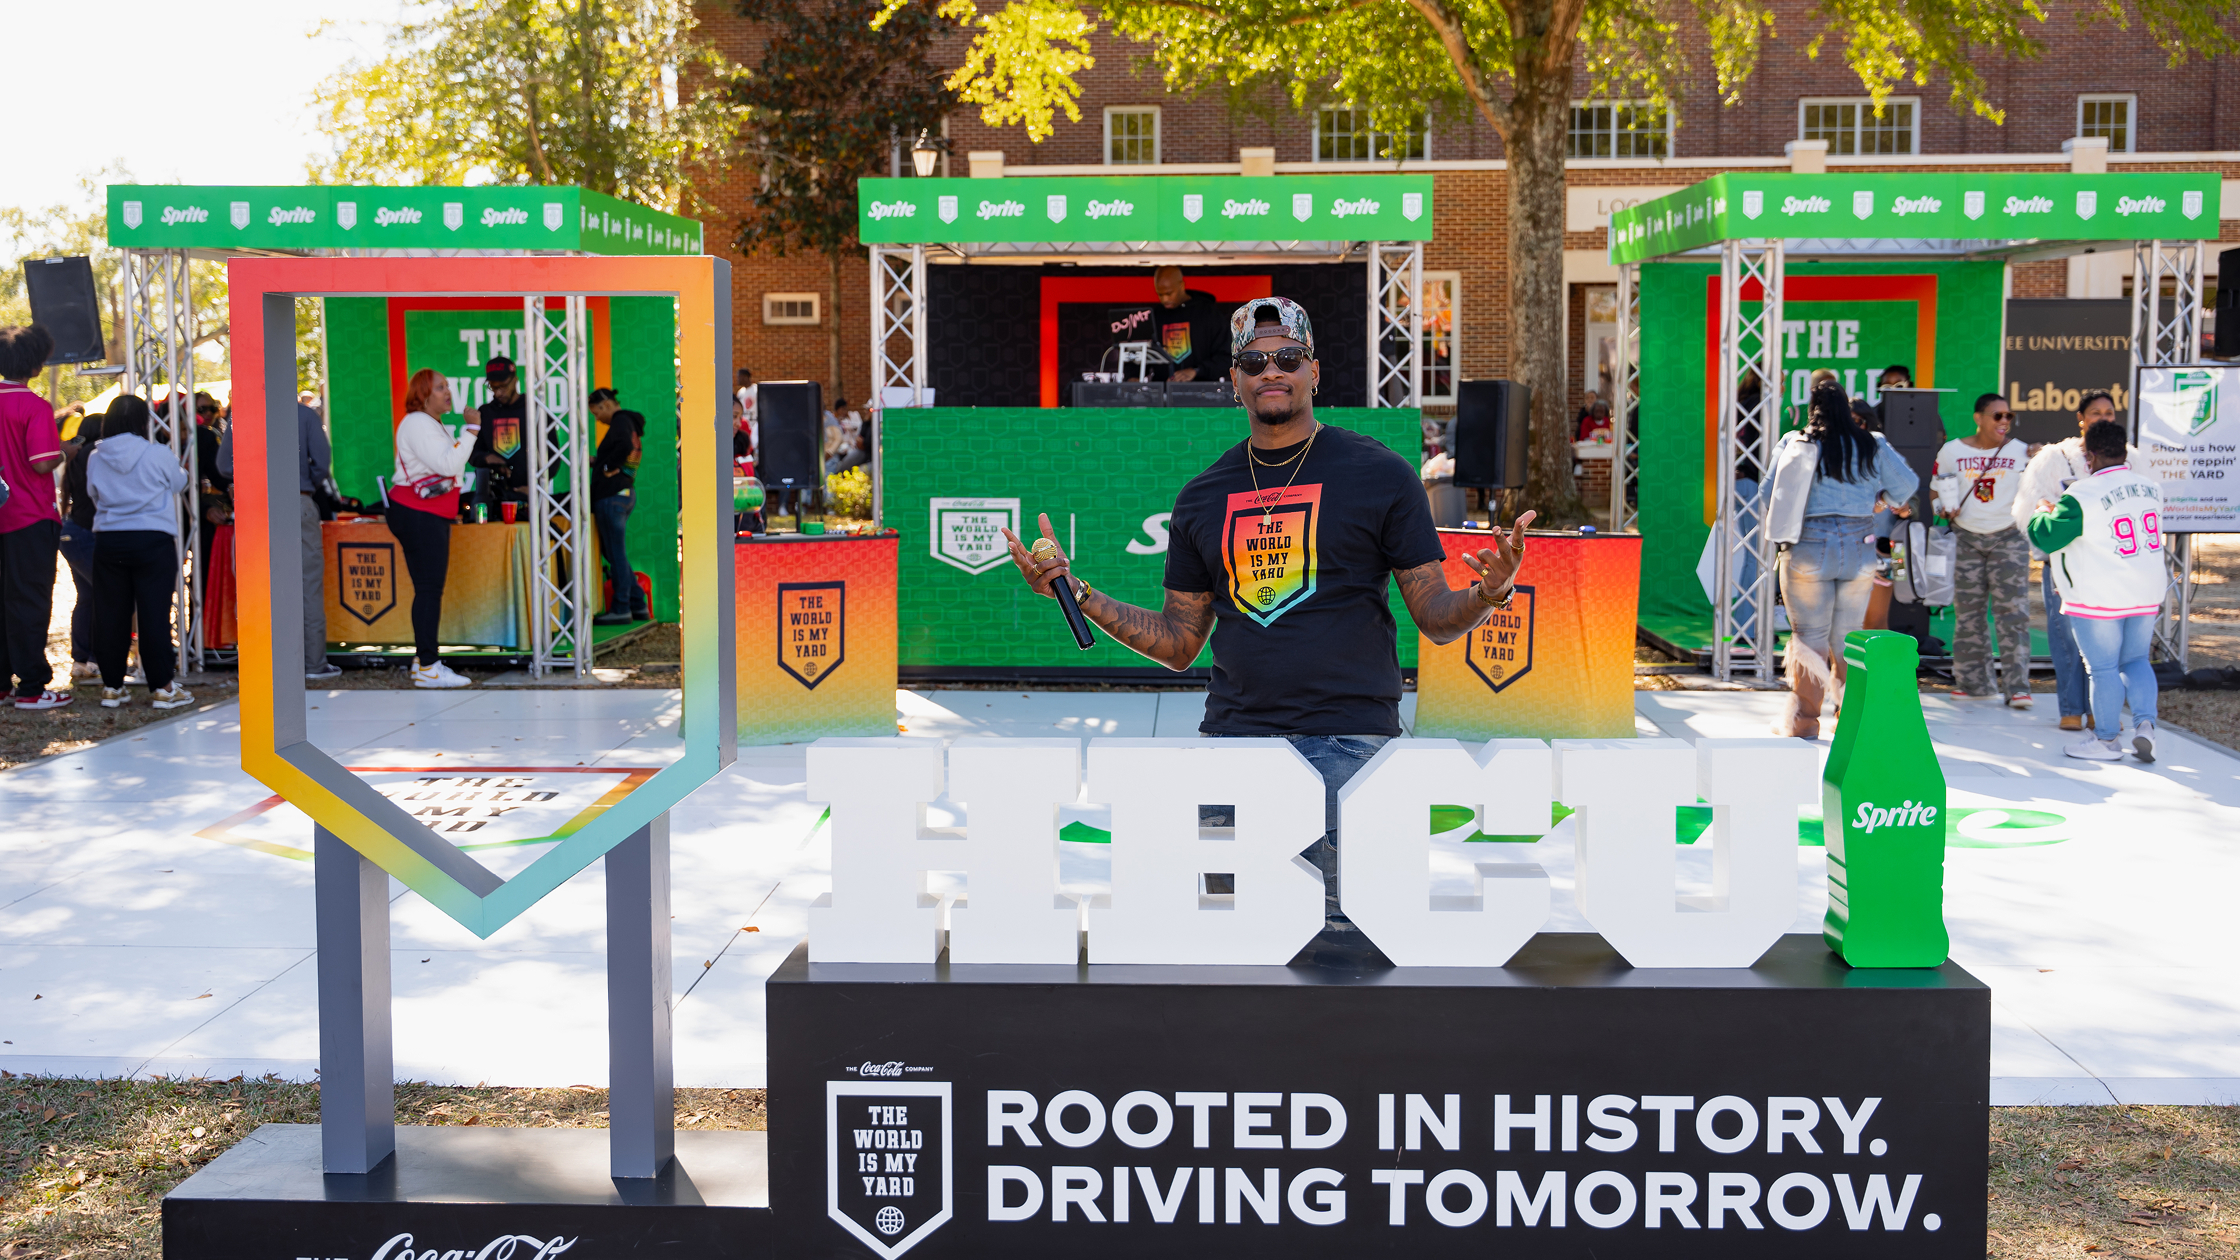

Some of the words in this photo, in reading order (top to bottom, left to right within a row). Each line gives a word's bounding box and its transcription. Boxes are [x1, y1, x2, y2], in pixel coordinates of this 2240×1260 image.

[867, 200, 916, 221] Sprite
[976, 199, 1025, 220] Sprite
[1085, 199, 1134, 219] Sprite
[1221, 198, 1270, 219] Sprite
[1331, 197, 1380, 218] Sprite
[1781, 195, 1831, 216] Sprite
[1891, 195, 1942, 216] Sprite
[2003, 195, 2054, 217] Sprite
[2115, 195, 2166, 217] Sprite
[161, 205, 209, 226] Sprite
[268, 206, 316, 227] Sprite
[374, 206, 423, 227] Sprite
[480, 207, 529, 228] Sprite
[1782, 320, 1860, 359] THE
[2028, 335, 2131, 351] UNIVERSITY
[2190, 445, 2205, 453] us
[2208, 443, 2236, 453] how
[2149, 457, 2189, 468] you're
[2161, 470, 2187, 479] THE
[2190, 470, 2225, 479] YARD
[961, 516, 988, 524] THE
[951, 525, 998, 533] WORLD
[1257, 521, 1283, 535] THE
[2110, 510, 2161, 557] 99
[955, 534, 967, 542] IS
[973, 534, 994, 542] MY
[1246, 536, 1291, 551] WORLD
[957, 543, 992, 551] YARD
[356, 553, 377, 564] THE
[1250, 555, 1263, 568] IS
[1267, 552, 1289, 566] MY
[349, 565, 385, 577] WORLD
[1252, 566, 1285, 582] YARD
[352, 578, 362, 589] IS
[366, 578, 382, 589] MY
[354, 590, 381, 601] YARD
[799, 596, 823, 609] THE
[790, 612, 832, 626] WORLD
[793, 629, 804, 642] IS
[809, 628, 828, 641] MY
[1481, 629, 1493, 642] IS
[1497, 631, 1517, 645] MY
[795, 644, 827, 657] YARD
[1483, 646, 1514, 661] YARD
[1852, 799, 1937, 834] Sprite
[806, 738, 1819, 968] HBCU
[859, 1060, 905, 1077] Coca-Cola
[868, 1105, 908, 1125] THE
[987, 1089, 1348, 1149] ROOTED
[1378, 1093, 1460, 1151] IN
[1494, 1094, 1888, 1156] HISTORY.
[853, 1129, 923, 1149] WORLD
[858, 1152, 878, 1172] IS
[885, 1153, 918, 1173] MY
[862, 1176, 915, 1197] YARD
[988, 1164, 1347, 1226] DRIVING
[1371, 1168, 1942, 1232] TOMORROW.
